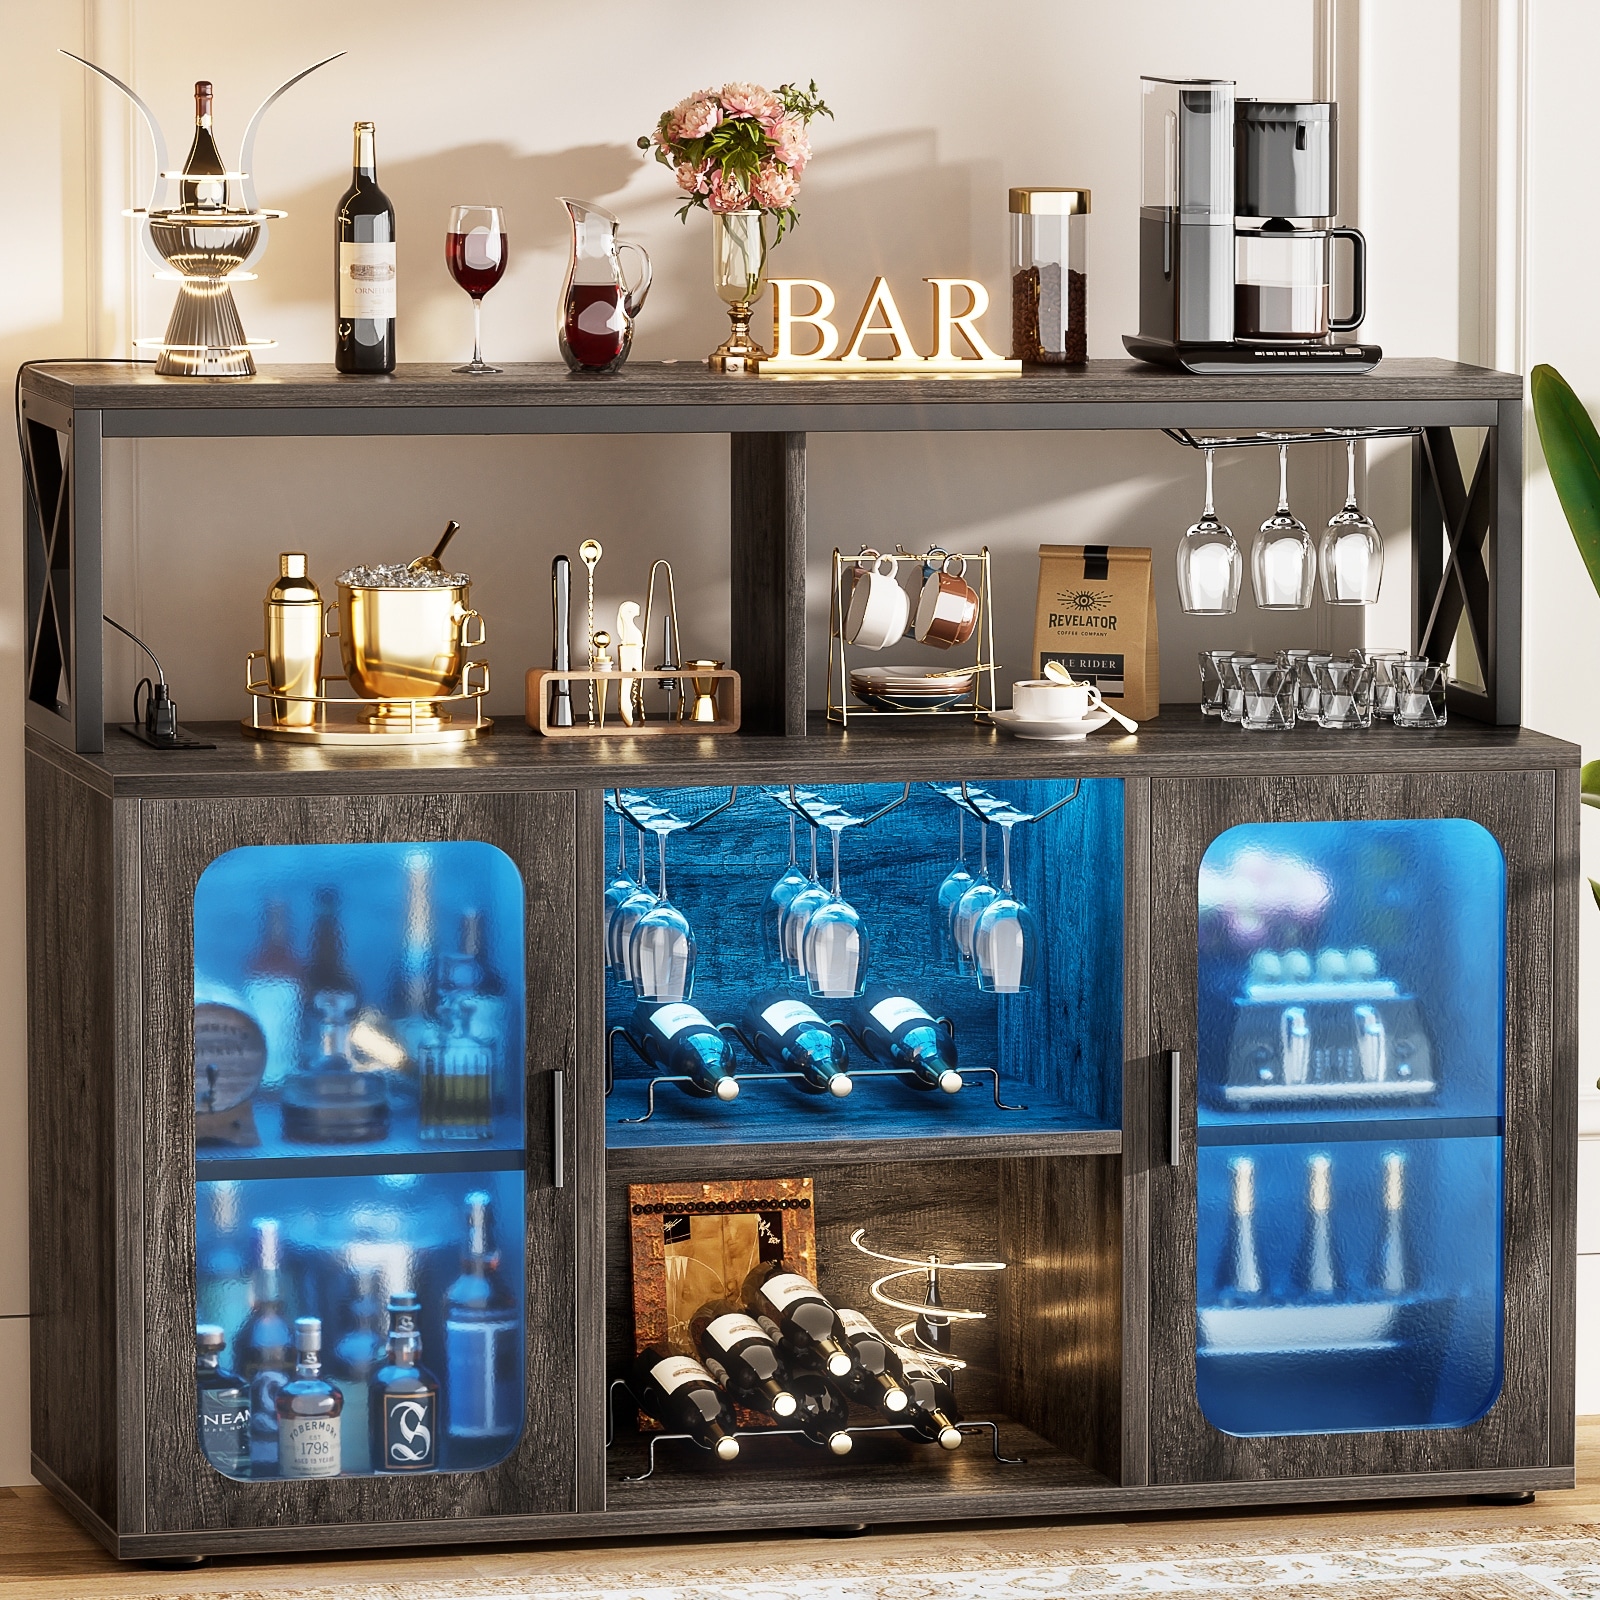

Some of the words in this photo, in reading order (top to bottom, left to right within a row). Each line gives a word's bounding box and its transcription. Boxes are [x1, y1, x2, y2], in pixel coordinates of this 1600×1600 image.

[764, 276, 1006, 361] BAR
[1049, 613, 1117, 630] REVELATOR
[1079, 659, 1116, 669] RIDER
[301, 1440, 329, 1455] 1798
